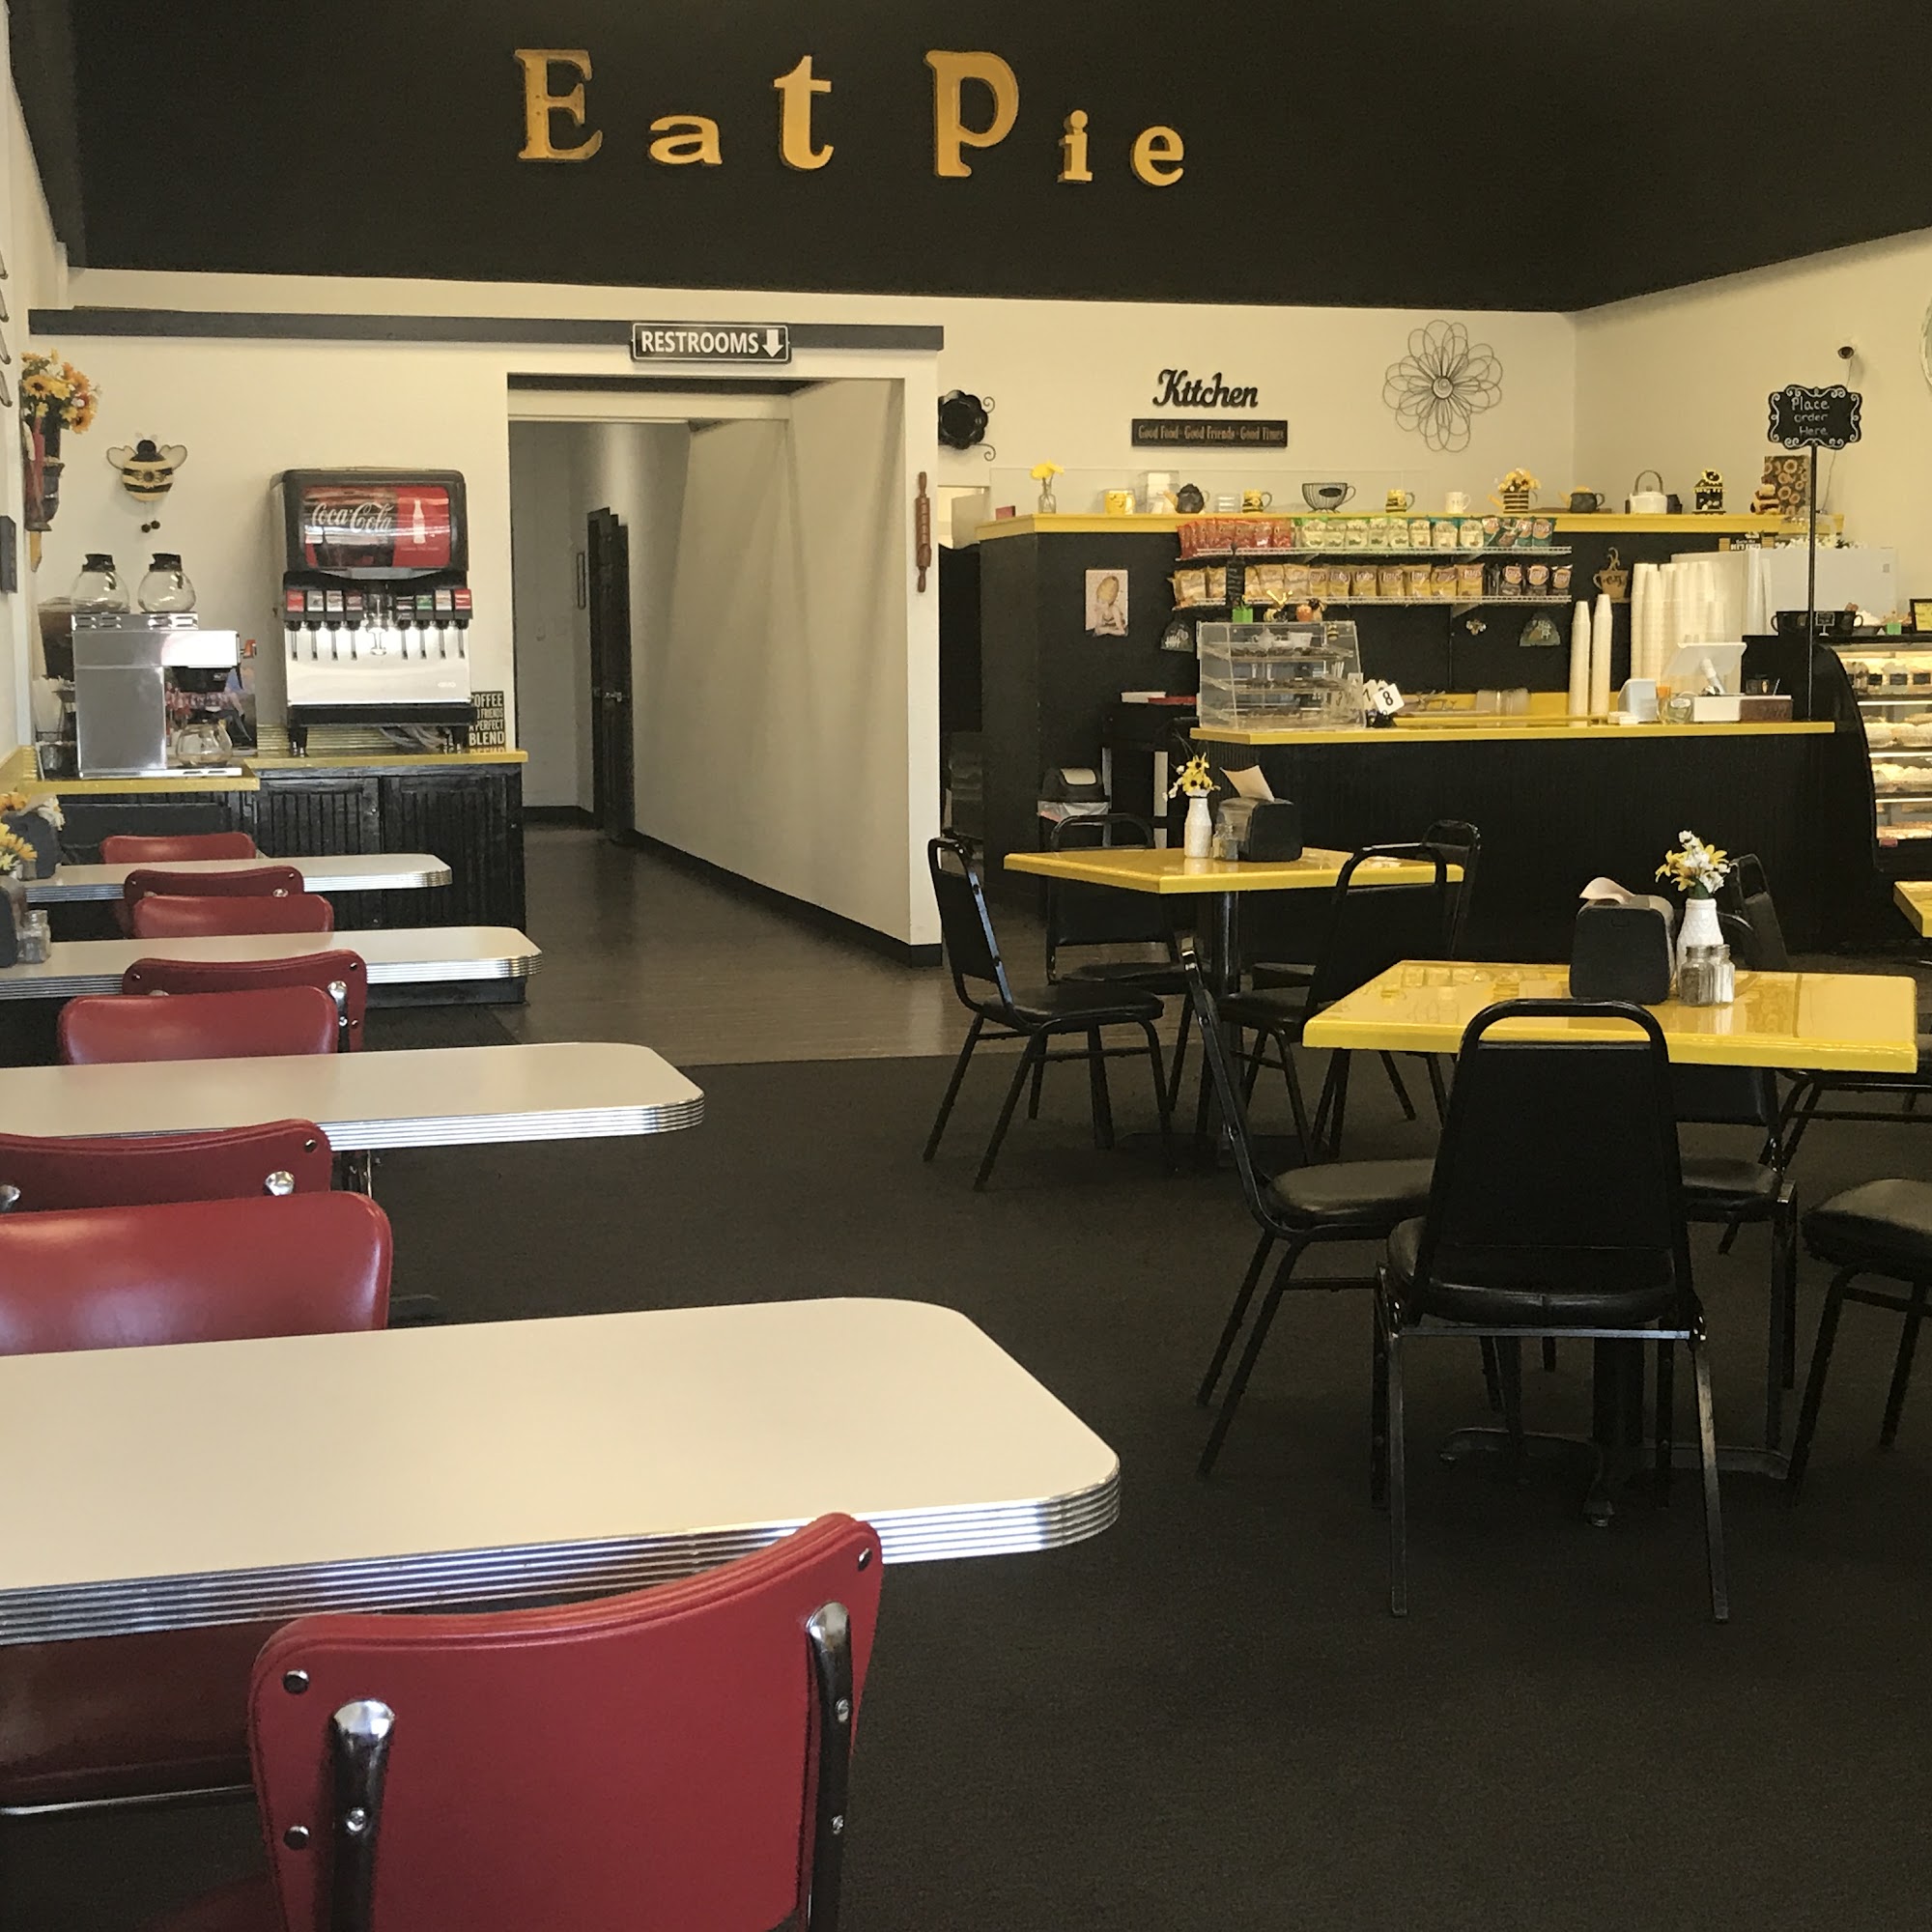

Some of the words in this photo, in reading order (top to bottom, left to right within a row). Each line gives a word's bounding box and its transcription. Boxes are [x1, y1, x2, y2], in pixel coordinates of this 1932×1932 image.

[513, 48, 835, 170] Eat
[923, 49, 1185, 187] Pie
[641, 330, 759, 355] RESTROOMS
[1152, 369, 1259, 408] Kitchen
[1791, 395, 1830, 411] Place
[1138, 425, 1158, 440] Good
[1160, 425, 1179, 440] Food
[1184, 425, 1205, 440] Good
[1208, 425, 1236, 440] Friends
[1239, 426, 1260, 441] Good
[1799, 426, 1829, 436] Here
[1382, 691, 1394, 706] 8
[469, 731, 505, 746] BLEND
